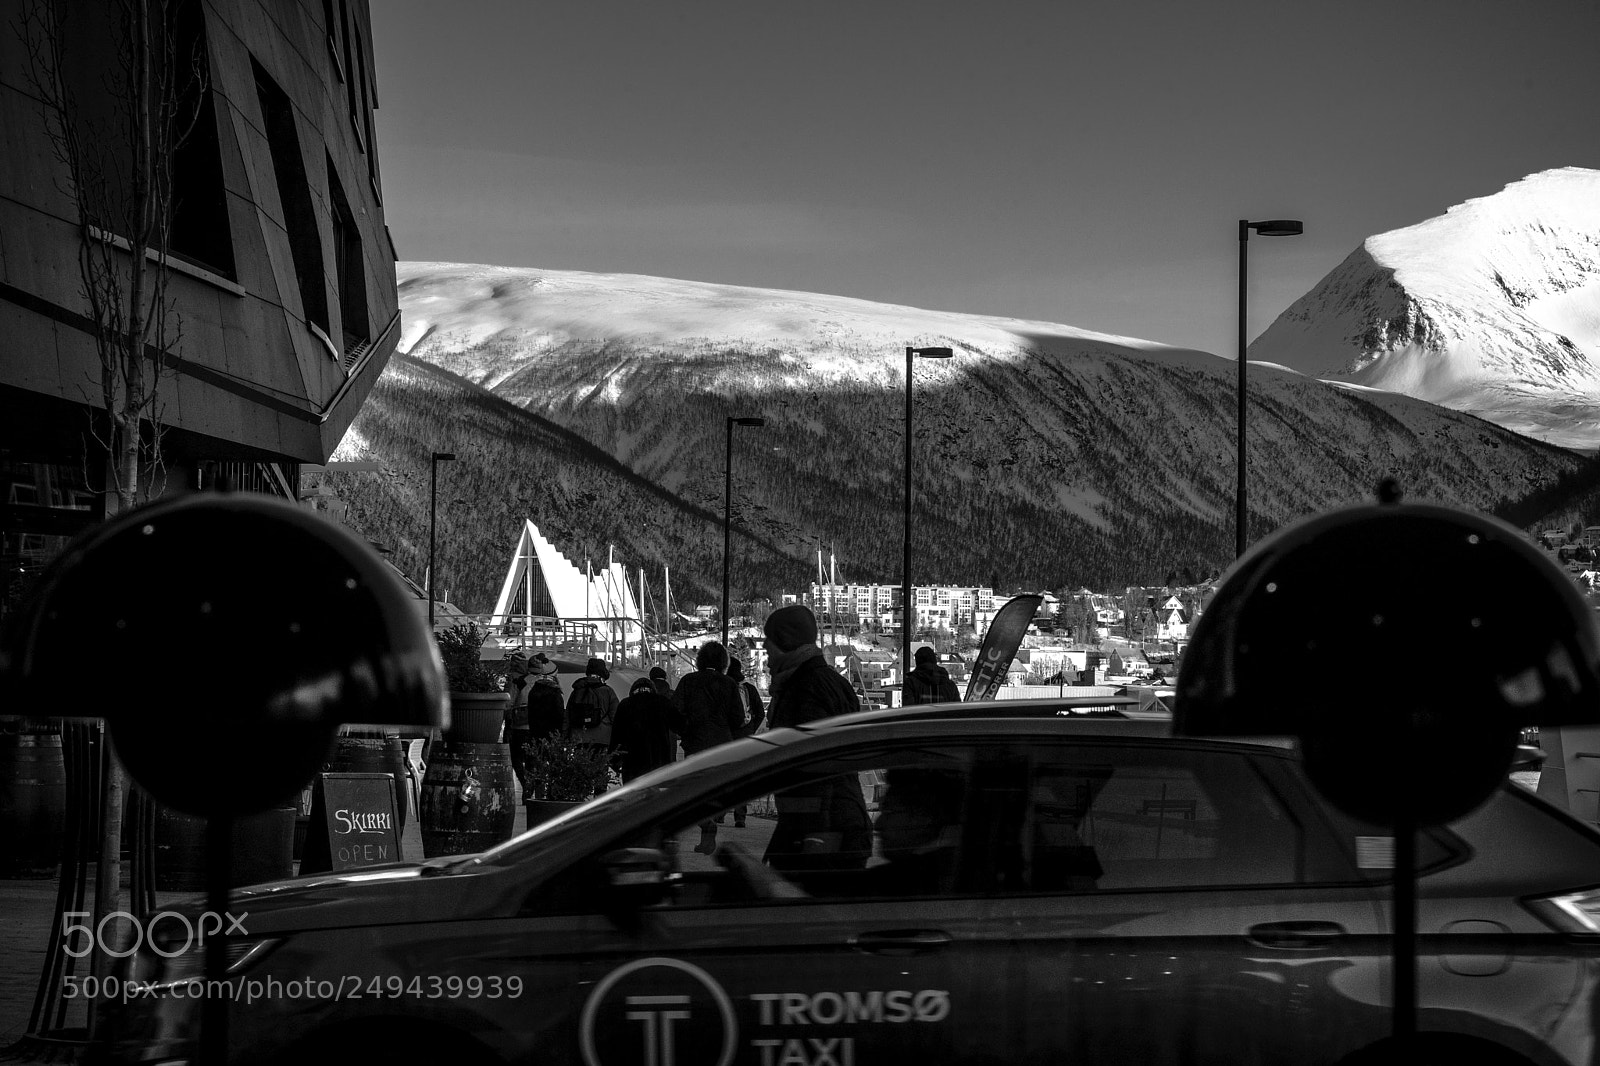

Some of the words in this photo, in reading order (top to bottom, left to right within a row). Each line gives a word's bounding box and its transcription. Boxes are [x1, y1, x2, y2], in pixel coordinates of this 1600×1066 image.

[338, 844, 388, 862] OPEN
[749, 990, 950, 1026] TROMSØ
[750, 1037, 856, 1066] TAXI
